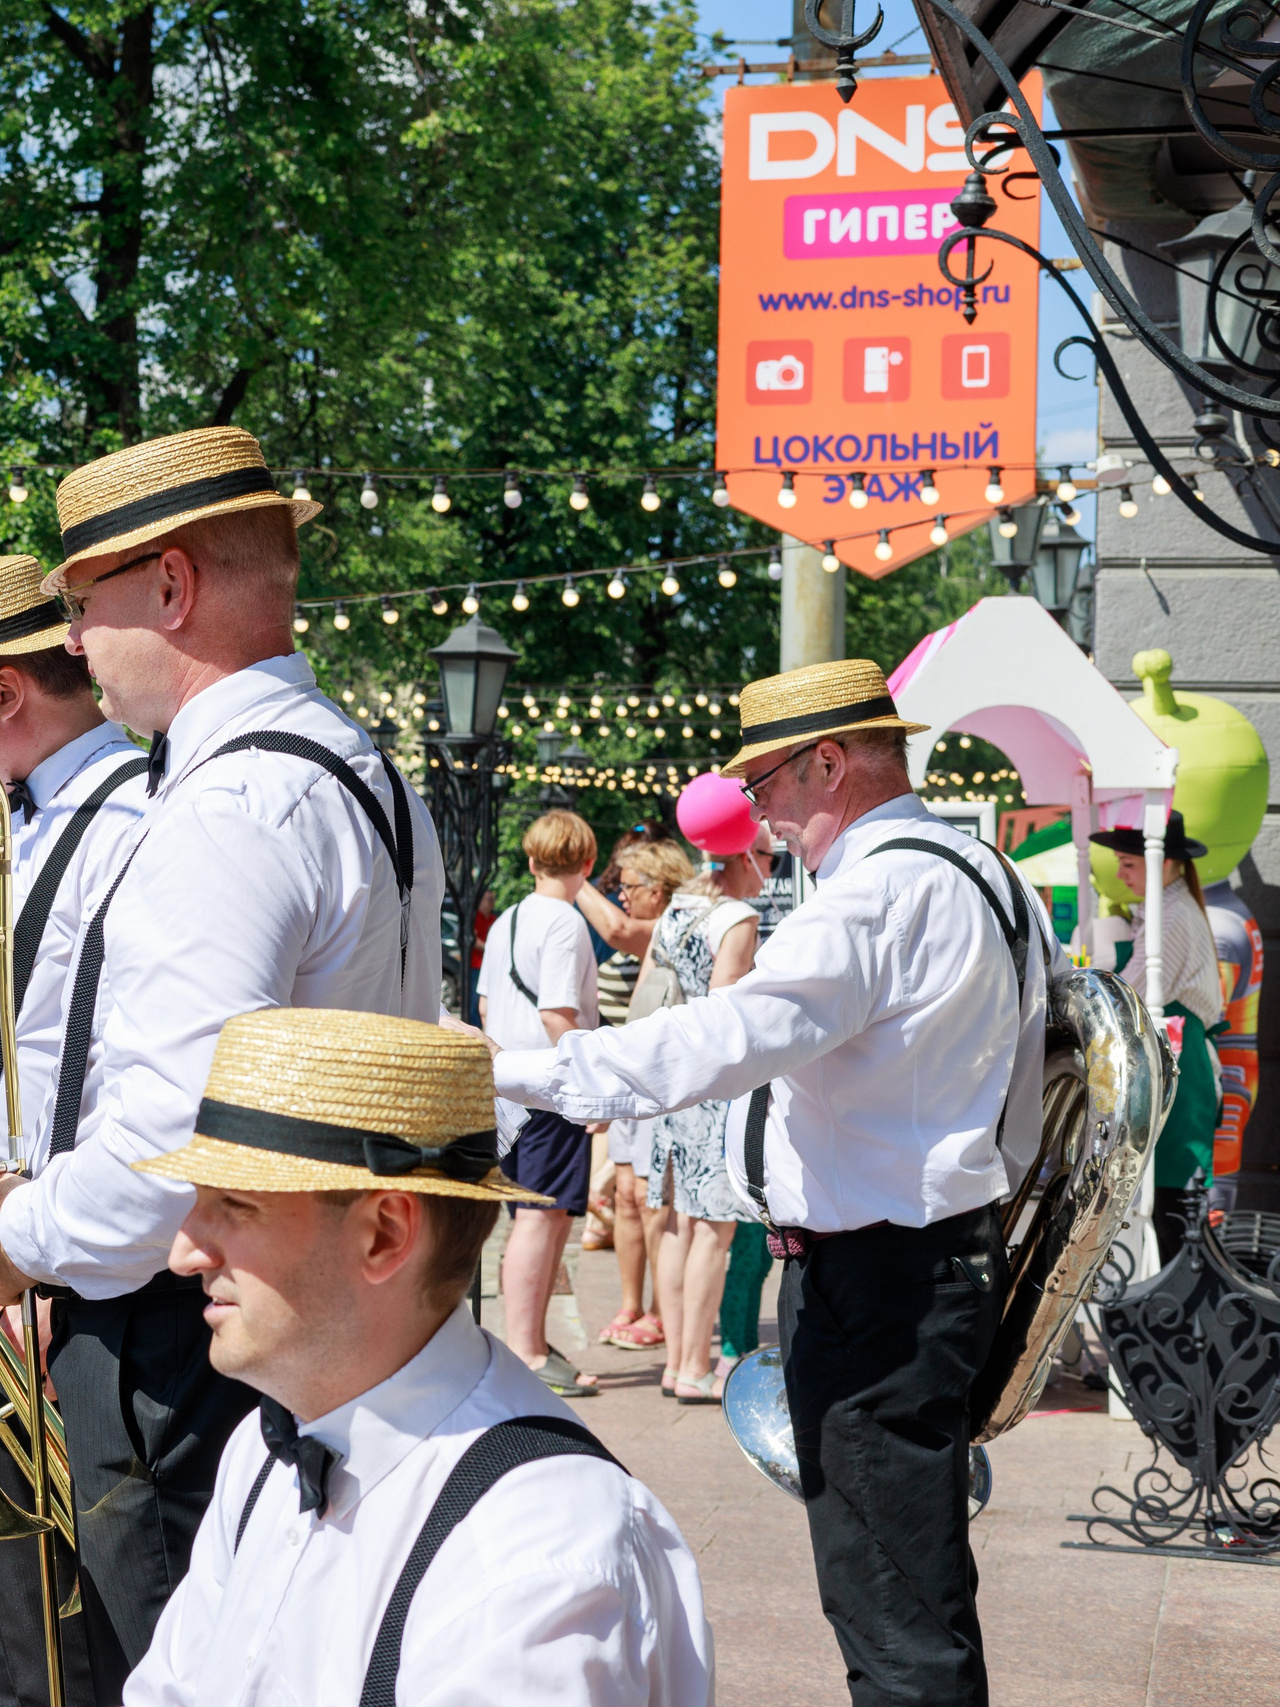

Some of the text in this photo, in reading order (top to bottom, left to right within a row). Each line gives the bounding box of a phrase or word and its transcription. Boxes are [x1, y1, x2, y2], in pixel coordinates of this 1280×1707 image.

[748, 101, 1014, 181] DNS
[803, 202, 960, 245] ГИПЕР
[758, 283, 1010, 312] www.dns-shopru
[753, 422, 999, 468] ЦОКОЛЬНЫЙ
[823, 473, 924, 503] ЭАЖ
